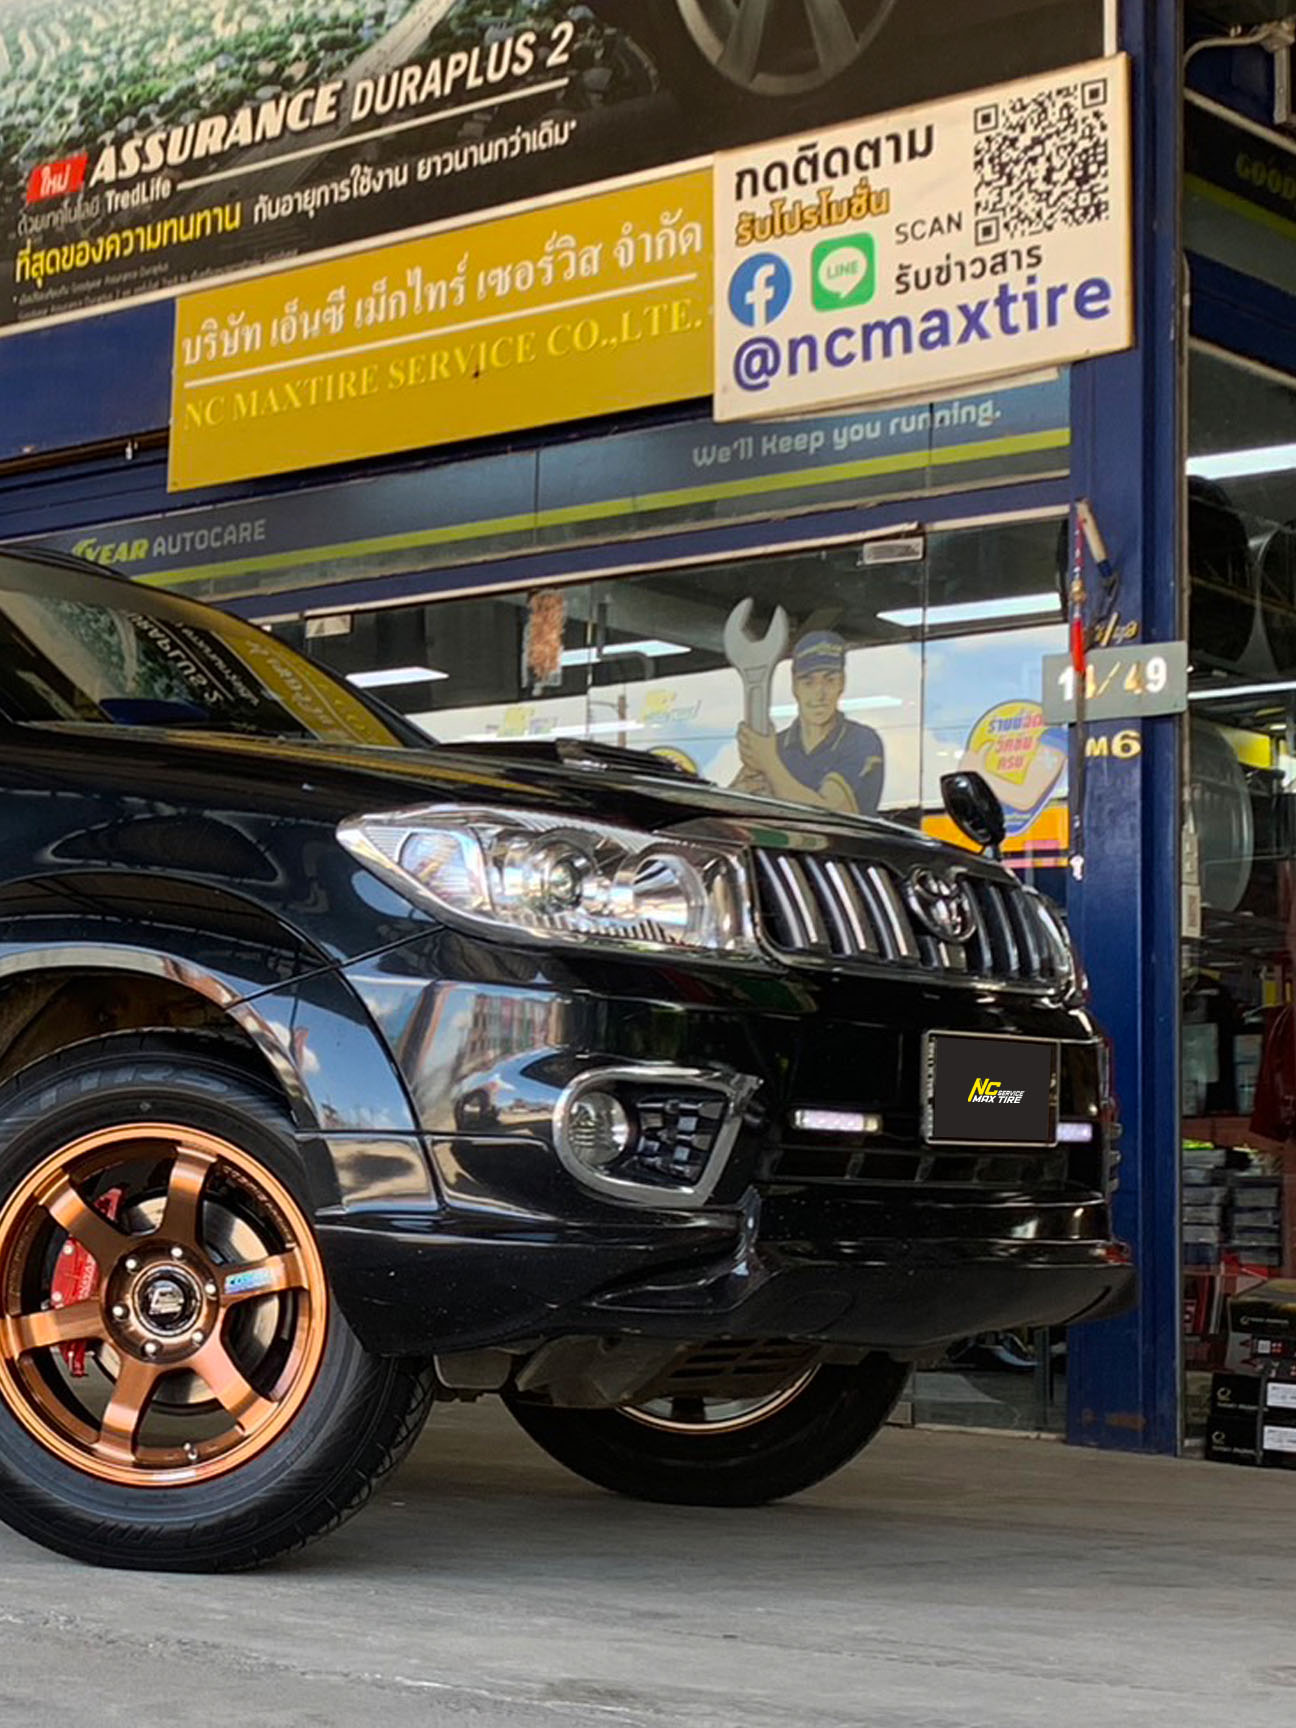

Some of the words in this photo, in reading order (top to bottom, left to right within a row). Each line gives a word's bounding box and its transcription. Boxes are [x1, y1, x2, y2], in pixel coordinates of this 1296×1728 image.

[89, 80, 343, 187] ASSURANCE
[350, 30, 537, 122] DURAPLUS
[546, 20, 574, 68] 2
[105, 178, 172, 214] TredLife
[735, 123, 935, 201] กดติดตาม
[15, 201, 242, 289] ที่สุดของความทนทาน
[253, 163, 409, 225] กับอายุการใช้งาน
[735, 176, 891, 247] รับโปรโมชั่น
[894, 211, 964, 246] SCAN
[182, 310, 262, 366] บริษัท
[270, 284, 346, 348] เอ็นซี
[354, 252, 469, 329] เม็กไทร์
[477, 230, 603, 301] เซอร์วิส
[614, 207, 704, 270] จำกัด
[826, 260, 860, 280] LINE
[895, 245, 1043, 295] รับข่าวสาร
[733, 274, 1112, 391] @ncmaxtire
[184, 395, 225, 431] NC
[232, 363, 379, 422] MAXTIRE
[387, 331, 536, 391] SERVICE
[832, 424, 881, 450] you
[889, 400, 1001, 435] running.
[152, 519, 267, 557] AUTOCARE
